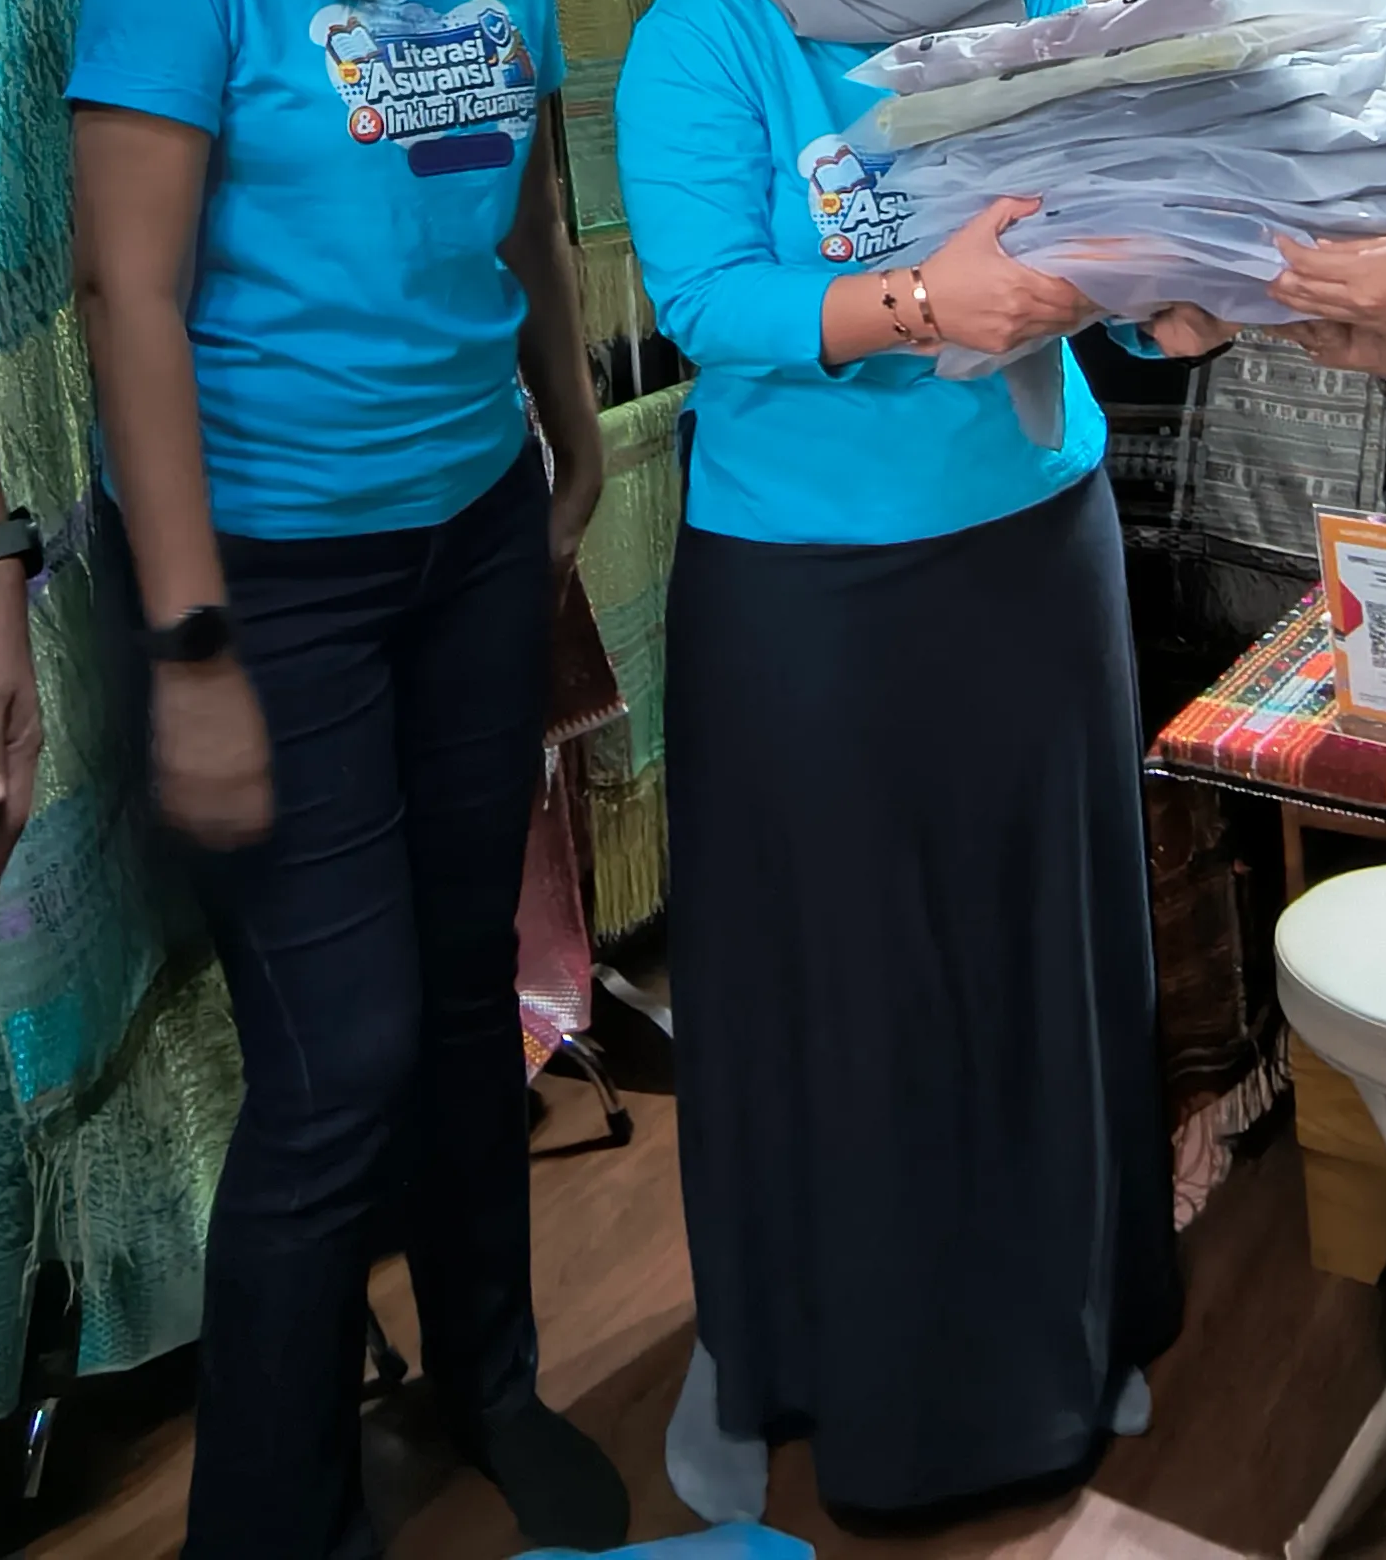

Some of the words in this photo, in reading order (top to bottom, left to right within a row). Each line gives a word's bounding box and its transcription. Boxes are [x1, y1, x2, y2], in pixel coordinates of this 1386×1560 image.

[387, 30, 486, 68] Literasi
[367, 58, 491, 100] Asuransi
[356, 111, 378, 135] &
[387, 98, 454, 134] Inklusi
